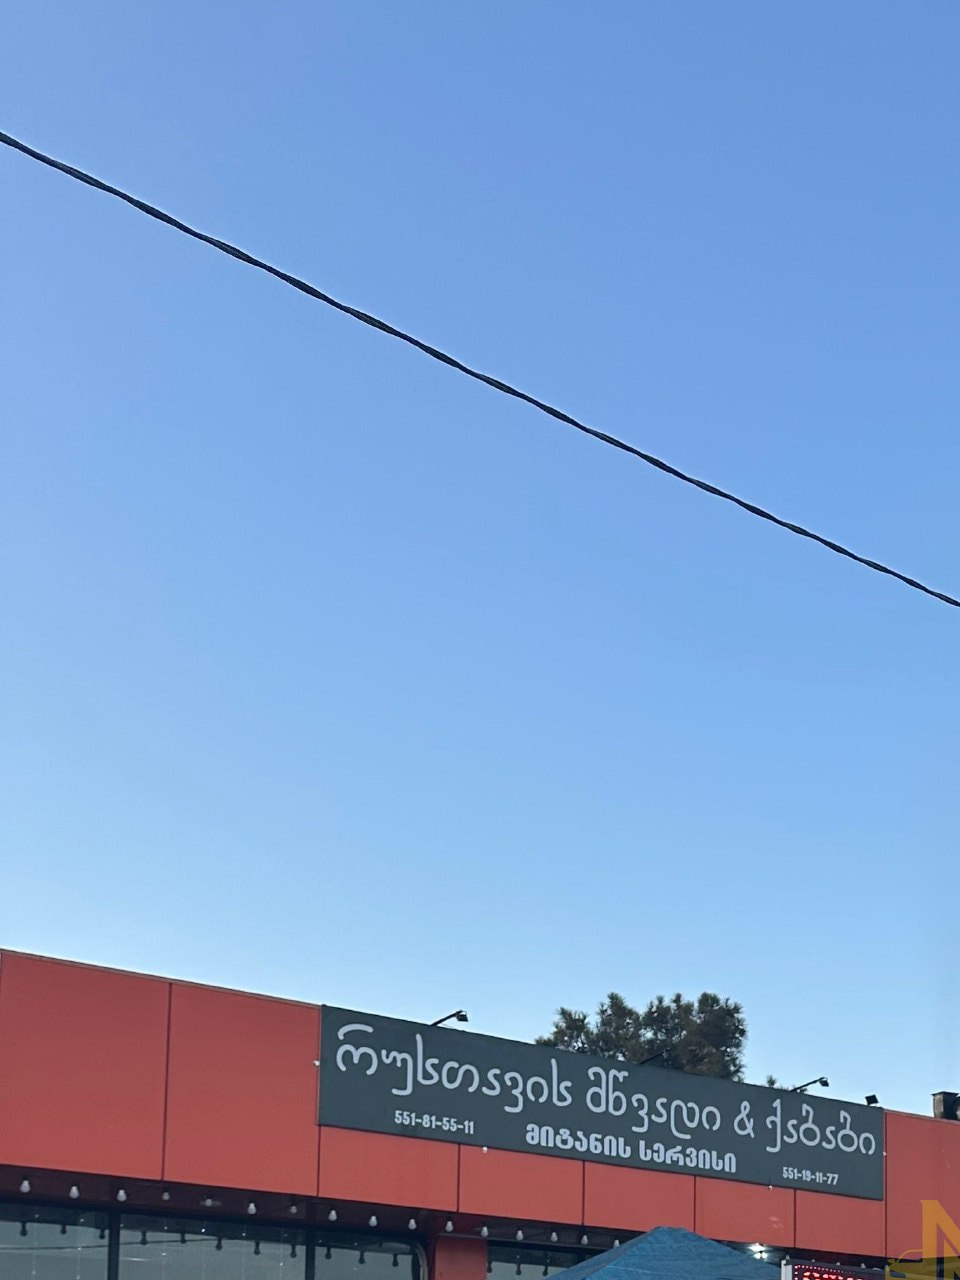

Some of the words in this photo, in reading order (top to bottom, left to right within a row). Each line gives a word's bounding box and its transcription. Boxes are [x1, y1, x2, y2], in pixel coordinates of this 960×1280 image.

[336, 1023, 572, 1113] რუსთავის
[586, 1066, 721, 1139] მწვადი
[734, 1100, 755, 1138] &
[765, 1099, 876, 1155] ქაბაბი
[394, 1110, 474, 1134] 551-81-55-11
[526, 1123, 631, 1158] მიტანის
[639, 1140, 736, 1173] სერვისი
[782, 1166, 839, 1185] 551-19-11-77
